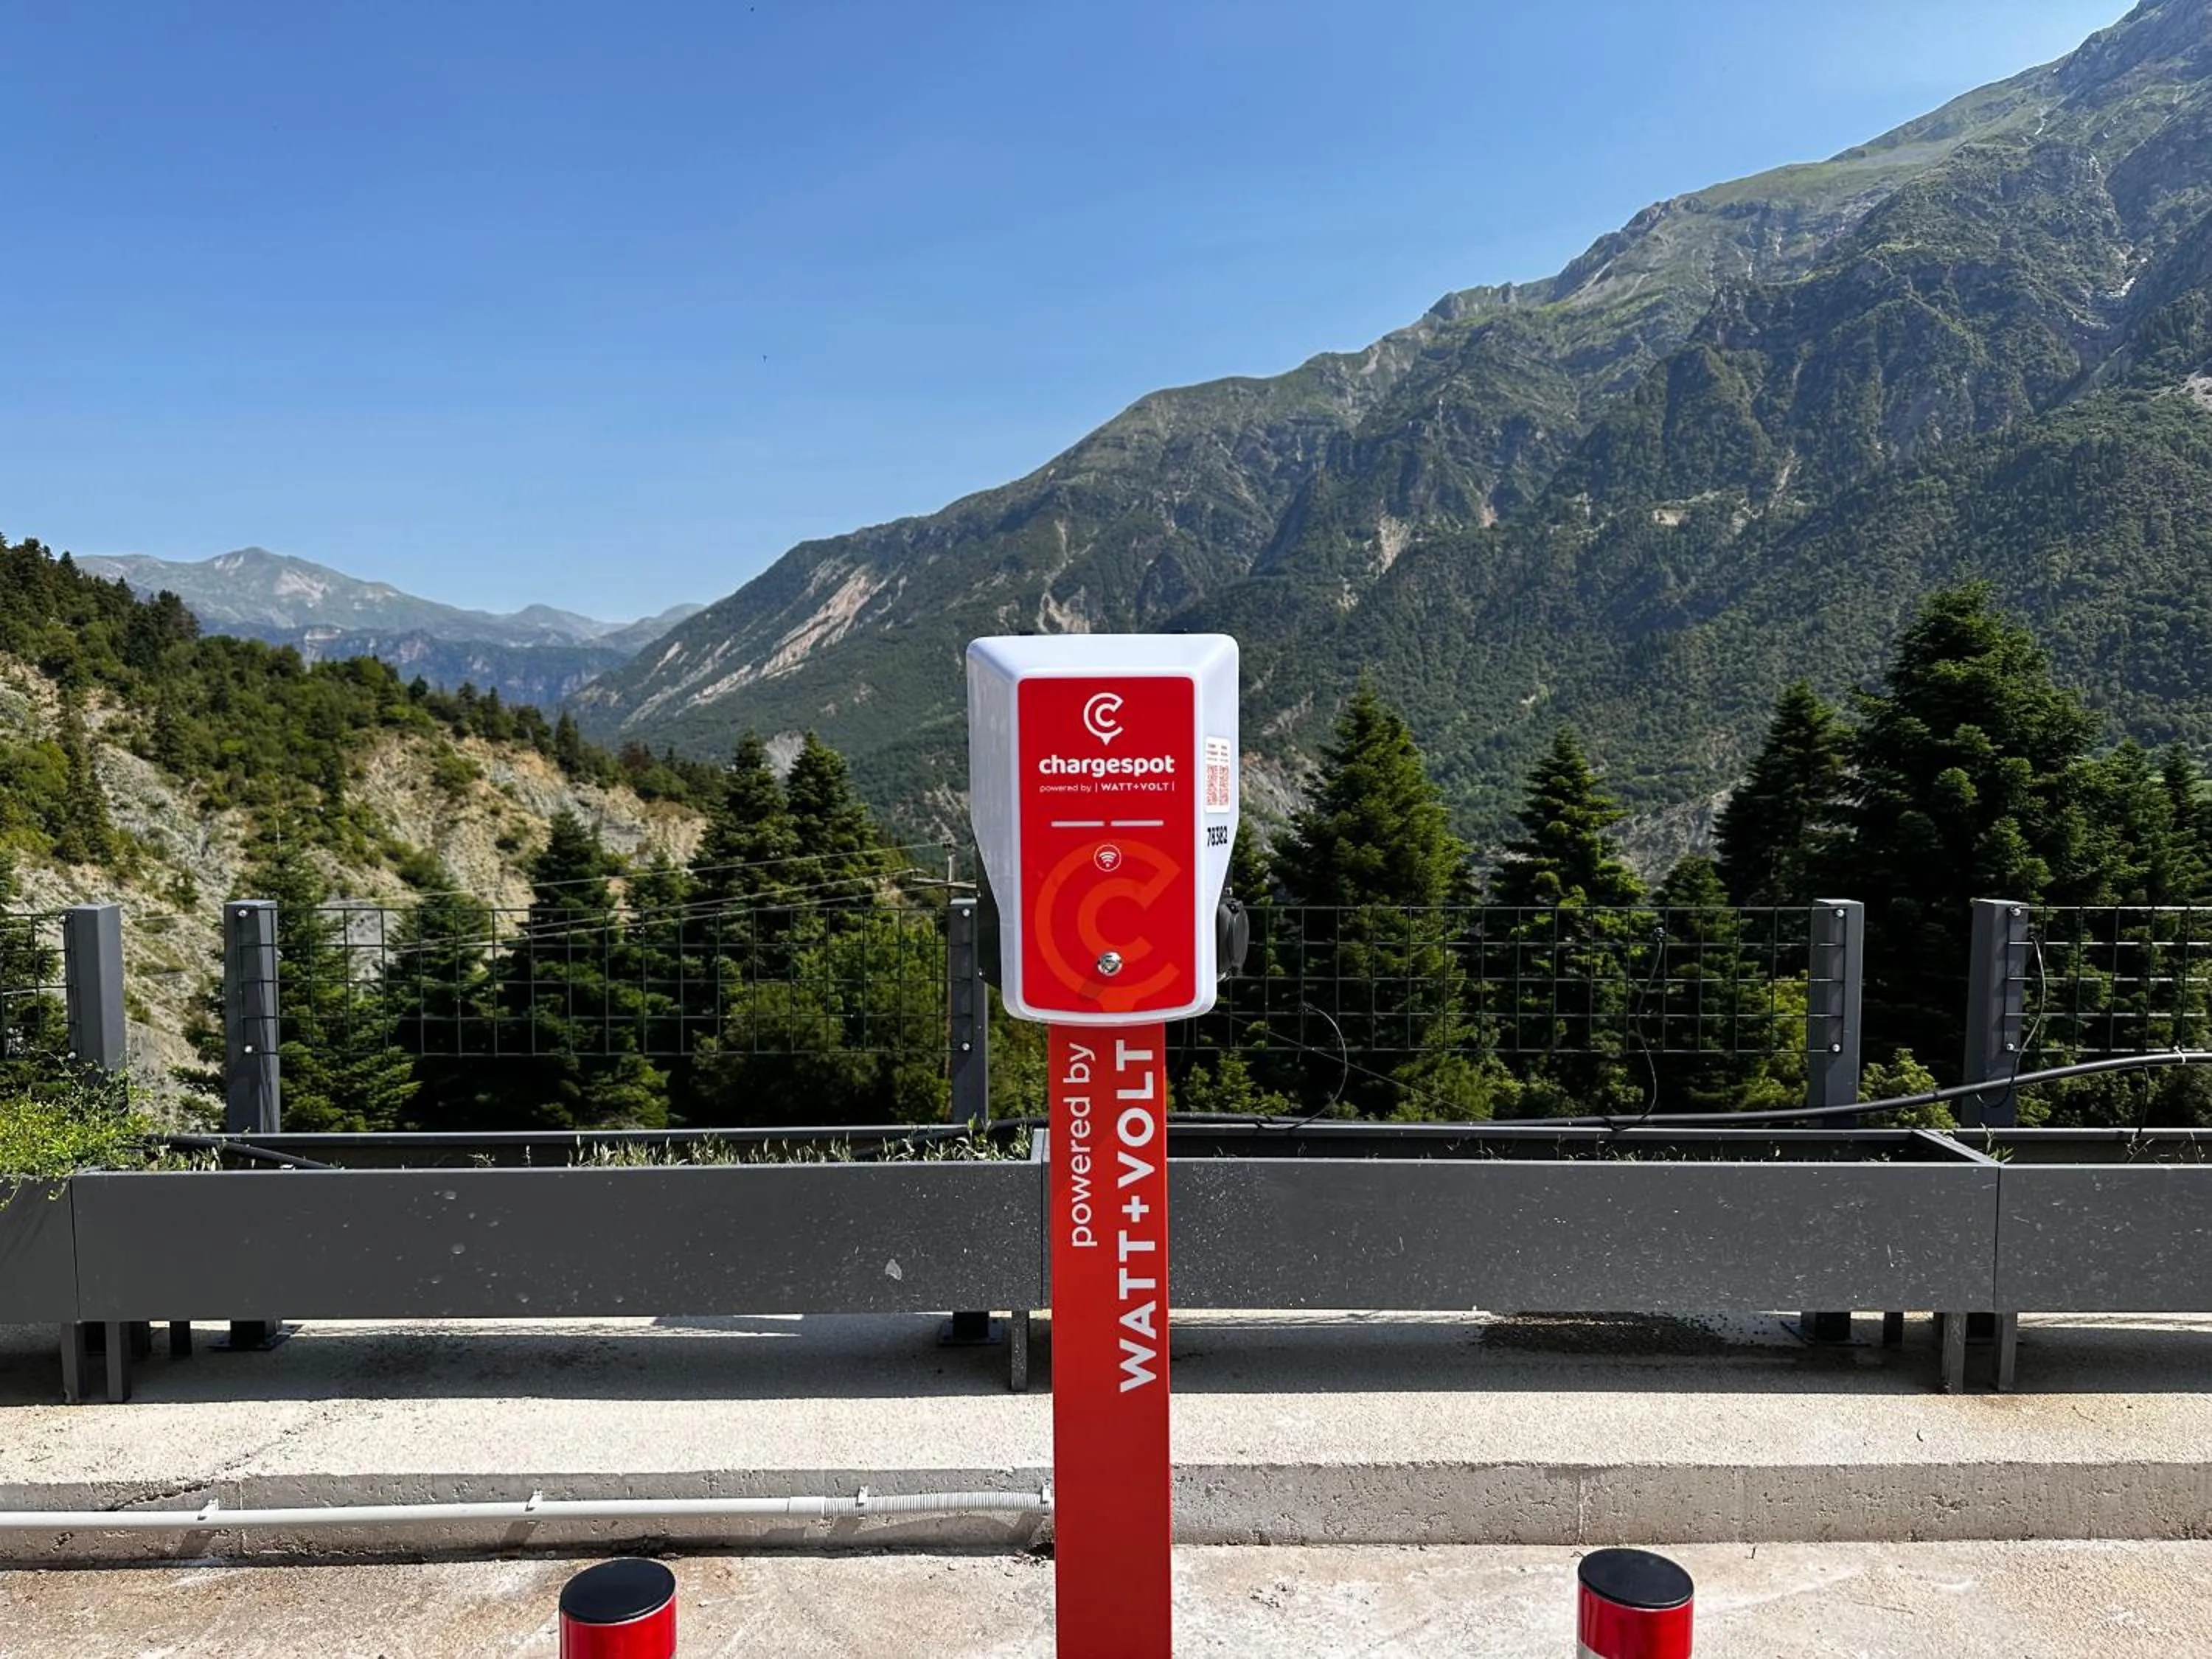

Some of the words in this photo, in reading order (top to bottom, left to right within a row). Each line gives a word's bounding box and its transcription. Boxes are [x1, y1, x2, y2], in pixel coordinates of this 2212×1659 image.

[1039, 754, 1175, 777] chargespot
[1040, 785, 1078, 793] powered
[1080, 784, 1092, 793] by
[1063, 1043, 1096, 1083] by
[1063, 1096, 1098, 1248] powered
